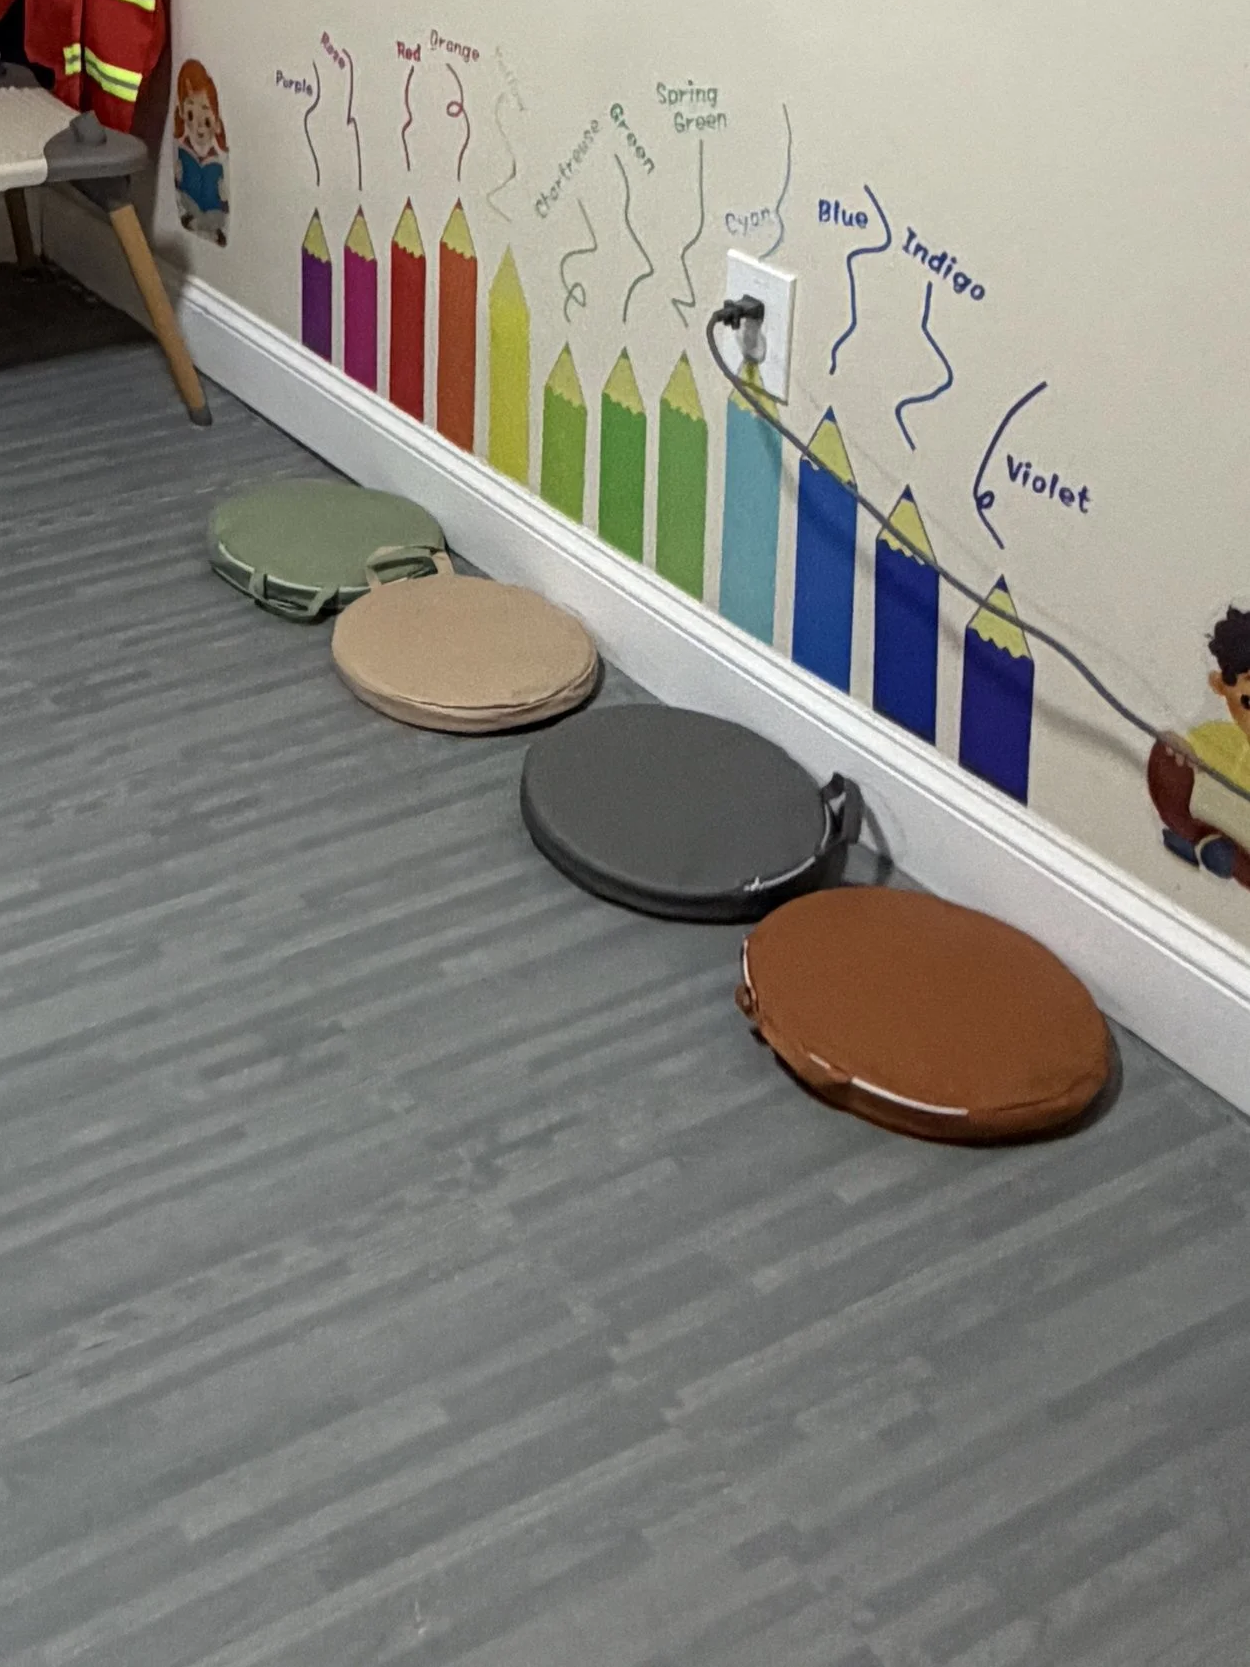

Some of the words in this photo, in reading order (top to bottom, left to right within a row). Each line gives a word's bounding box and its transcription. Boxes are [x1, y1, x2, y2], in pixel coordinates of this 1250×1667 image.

[396, 40, 422, 63] Red
[430, 29, 480, 63] Orange
[275, 69, 314, 97] Purple
[656, 79, 718, 108] Spring
[673, 112, 728, 134] Green
[610, 103, 656, 175] Green
[724, 207, 770, 236] Cyan
[818, 198, 869, 229] Blue
[902, 226, 986, 301] Indigo
[1006, 454, 1093, 514] Violet
